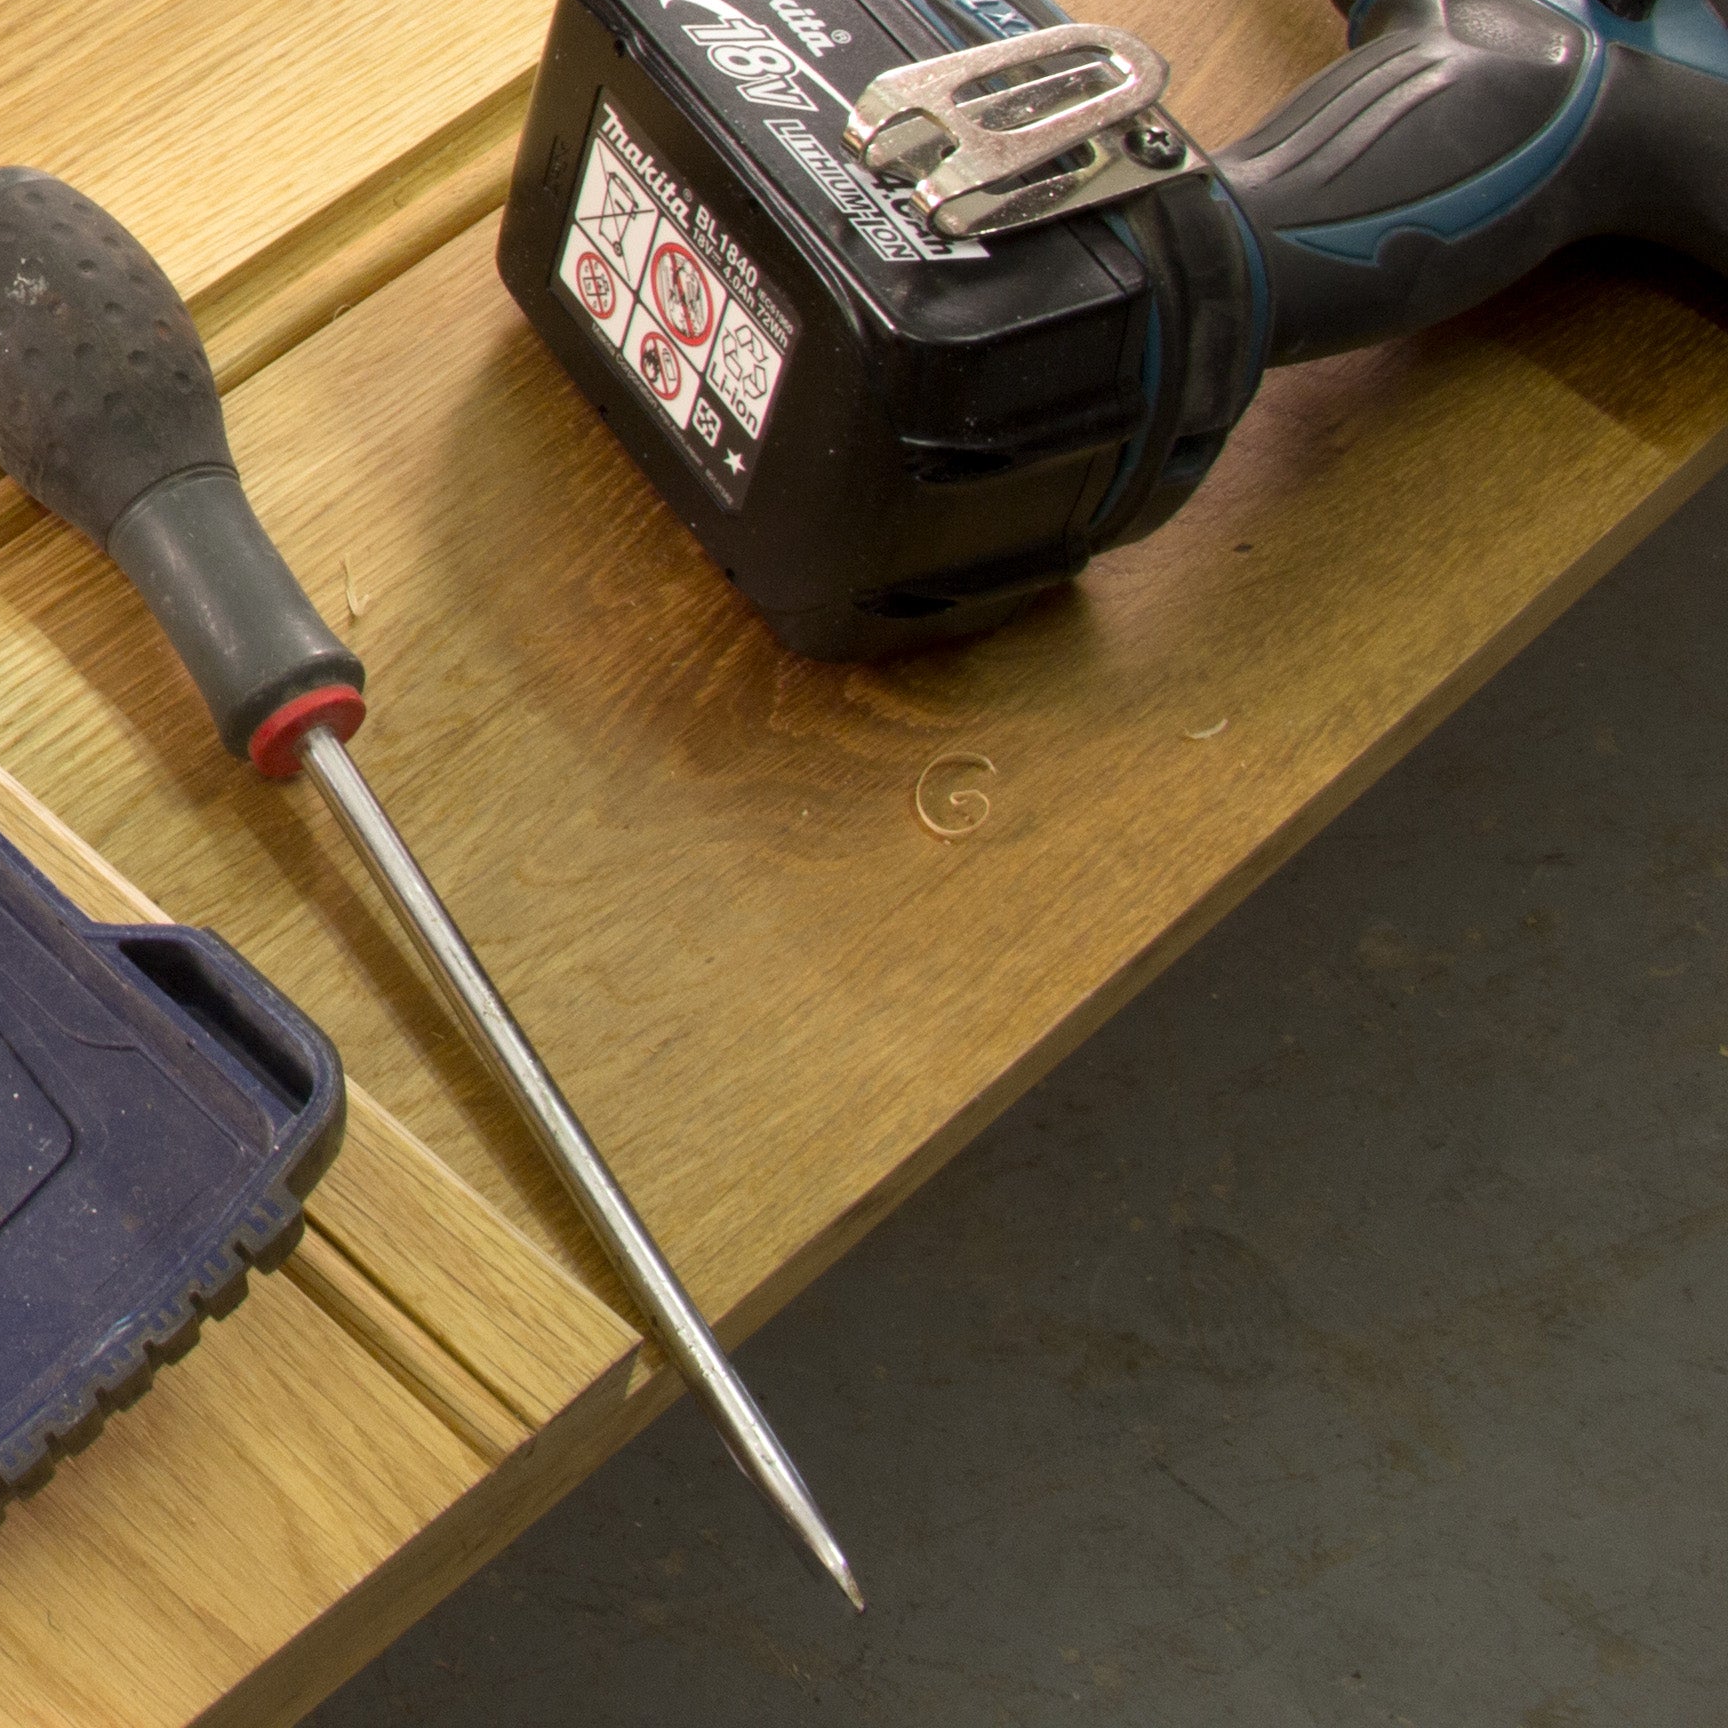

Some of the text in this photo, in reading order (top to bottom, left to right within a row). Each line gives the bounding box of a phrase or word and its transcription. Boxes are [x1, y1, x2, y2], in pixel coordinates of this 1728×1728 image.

[764, 117, 925, 261] LITHIUM-ION
[695, 205, 759, 288] BL1840
[722, 264, 757, 311] 4.0Ah
[755, 302, 790, 348] 72Wh
[708, 360, 760, 437] Li-ion
